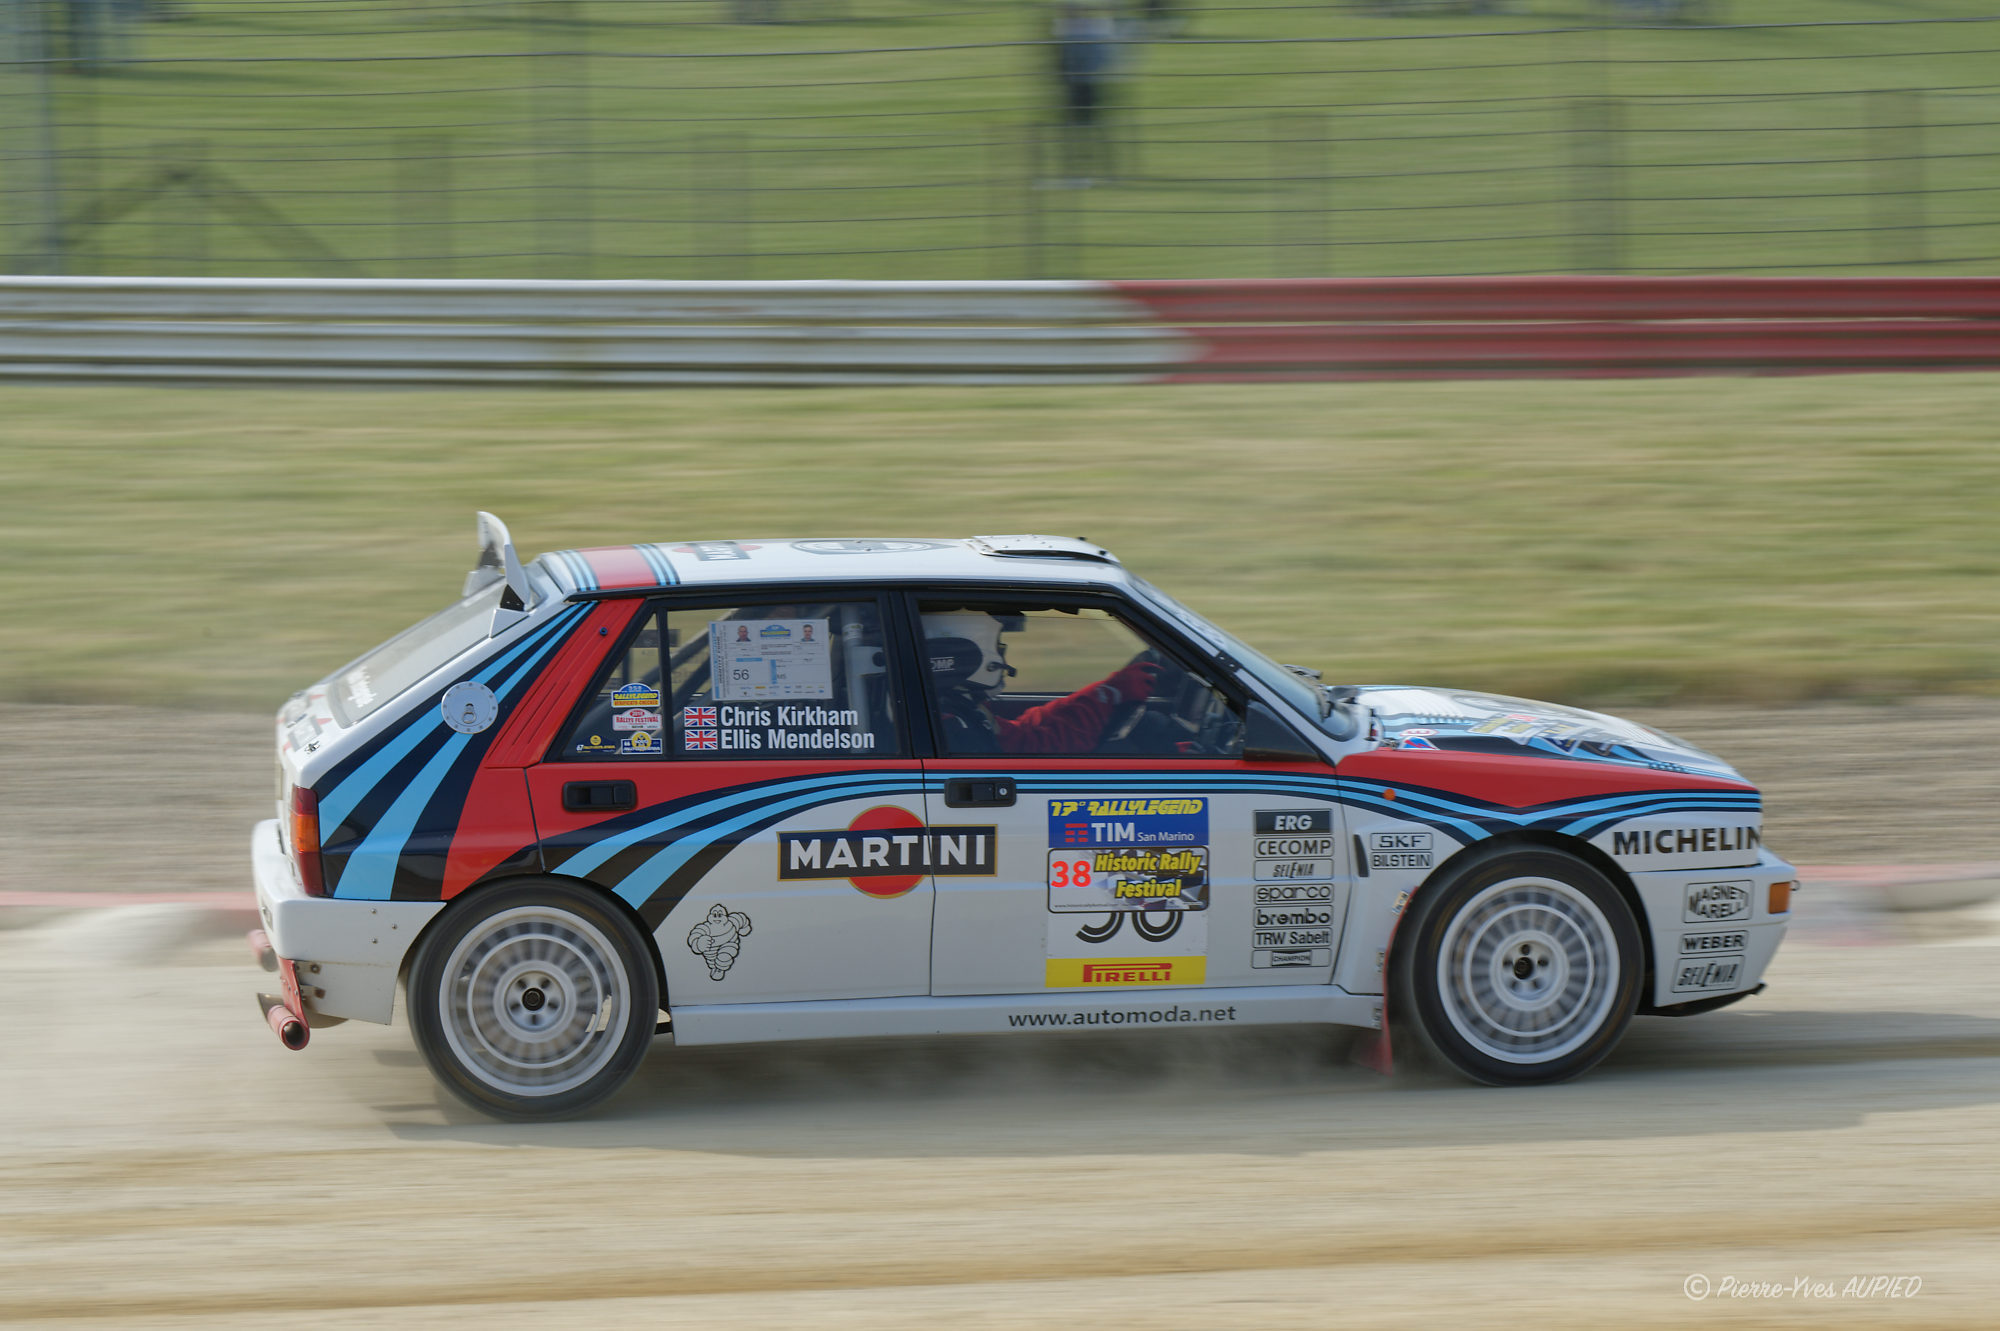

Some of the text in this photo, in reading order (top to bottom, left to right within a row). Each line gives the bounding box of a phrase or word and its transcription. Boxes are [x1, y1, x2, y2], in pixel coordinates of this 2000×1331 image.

[733, 669, 750, 680] 56
[720, 706, 858, 726] Chris Kirkham
[721, 729, 875, 749] Ellis Mendelson
[1087, 799, 1204, 816] RALLYLEGEND
[1091, 822, 1195, 842] TIM San Marino
[1274, 815, 1313, 831] ERG
[1257, 840, 1332, 855] CECOMP
[1379, 835, 1426, 848] SKF
[1613, 826, 1763, 855] MICHELIN
[790, 834, 986, 870] MARTINI
[1373, 854, 1431, 867] BILSTEIN
[1095, 851, 1201, 875] Historic Rally
[1050, 860, 1092, 888] 38
[1115, 879, 1182, 898] Festival
[1257, 886, 1331, 902] sparco
[1257, 908, 1331, 926] brembo
[1256, 931, 1329, 946] TRW Sabelt
[1684, 935, 1744, 949] WEBER
[1083, 963, 1173, 983] PIRELLI
[1008, 1005, 1237, 1027] www.automoda.net
